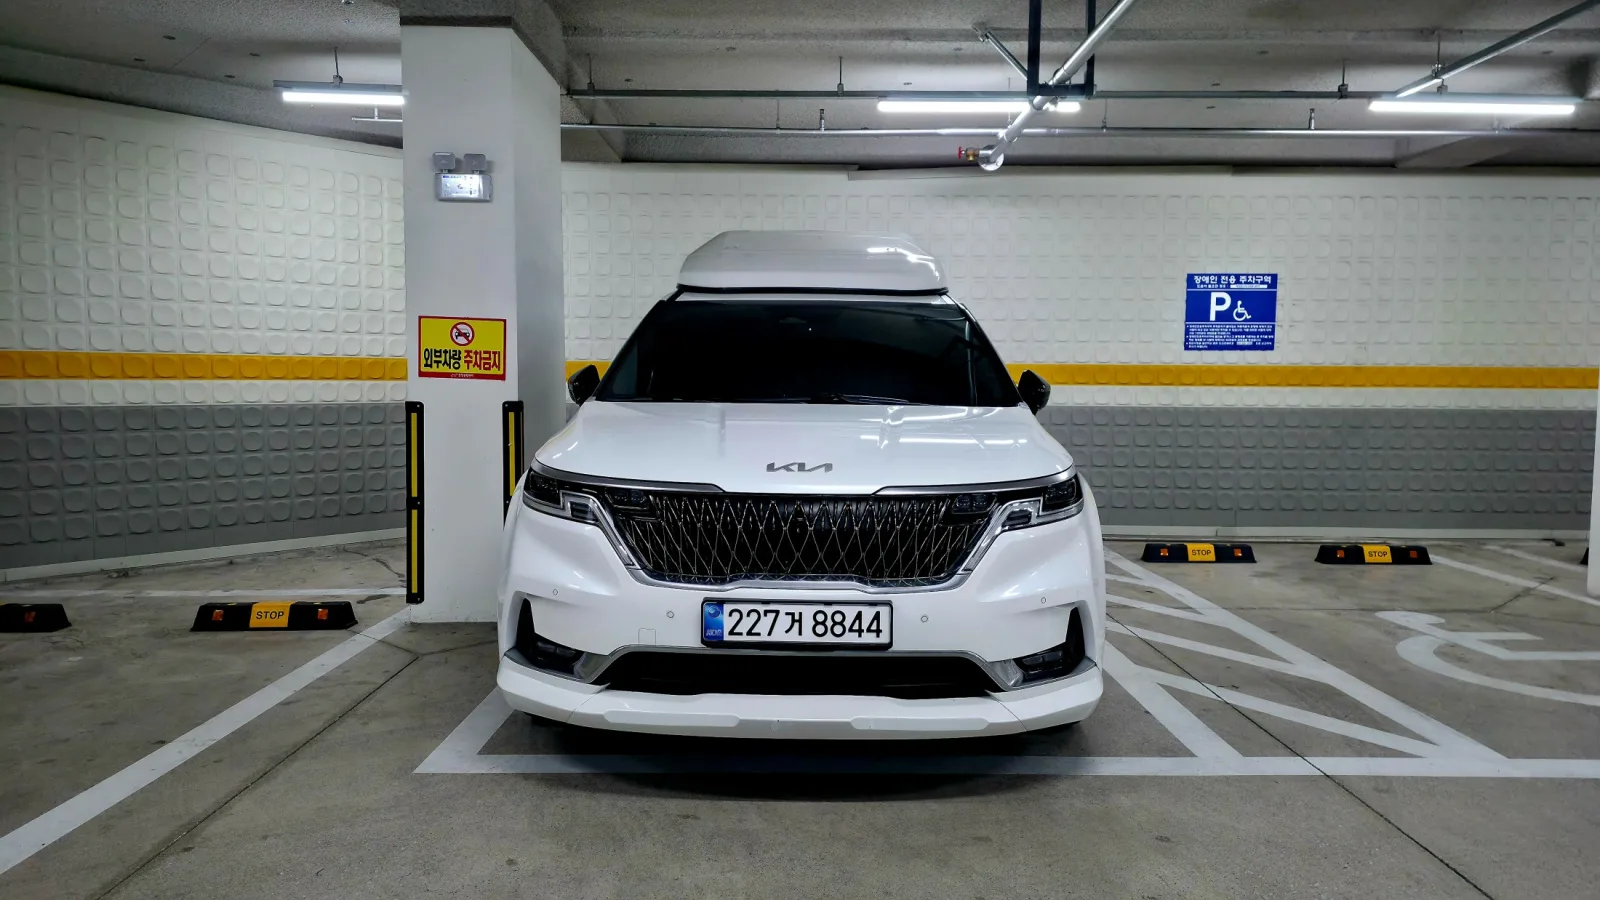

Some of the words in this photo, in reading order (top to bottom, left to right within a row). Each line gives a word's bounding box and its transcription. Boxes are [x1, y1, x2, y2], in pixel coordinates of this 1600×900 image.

[1194, 275, 1218, 284] 장애인
[1220, 275, 1236, 284] 전용
[1239, 275, 1271, 284] 주차구역
[1209, 292, 1232, 321] P
[423, 348, 462, 370] 외부차량
[463, 349, 501, 371] 주차금지
[255, 610, 285, 620] STOP
[811, 609, 883, 639] 8844
